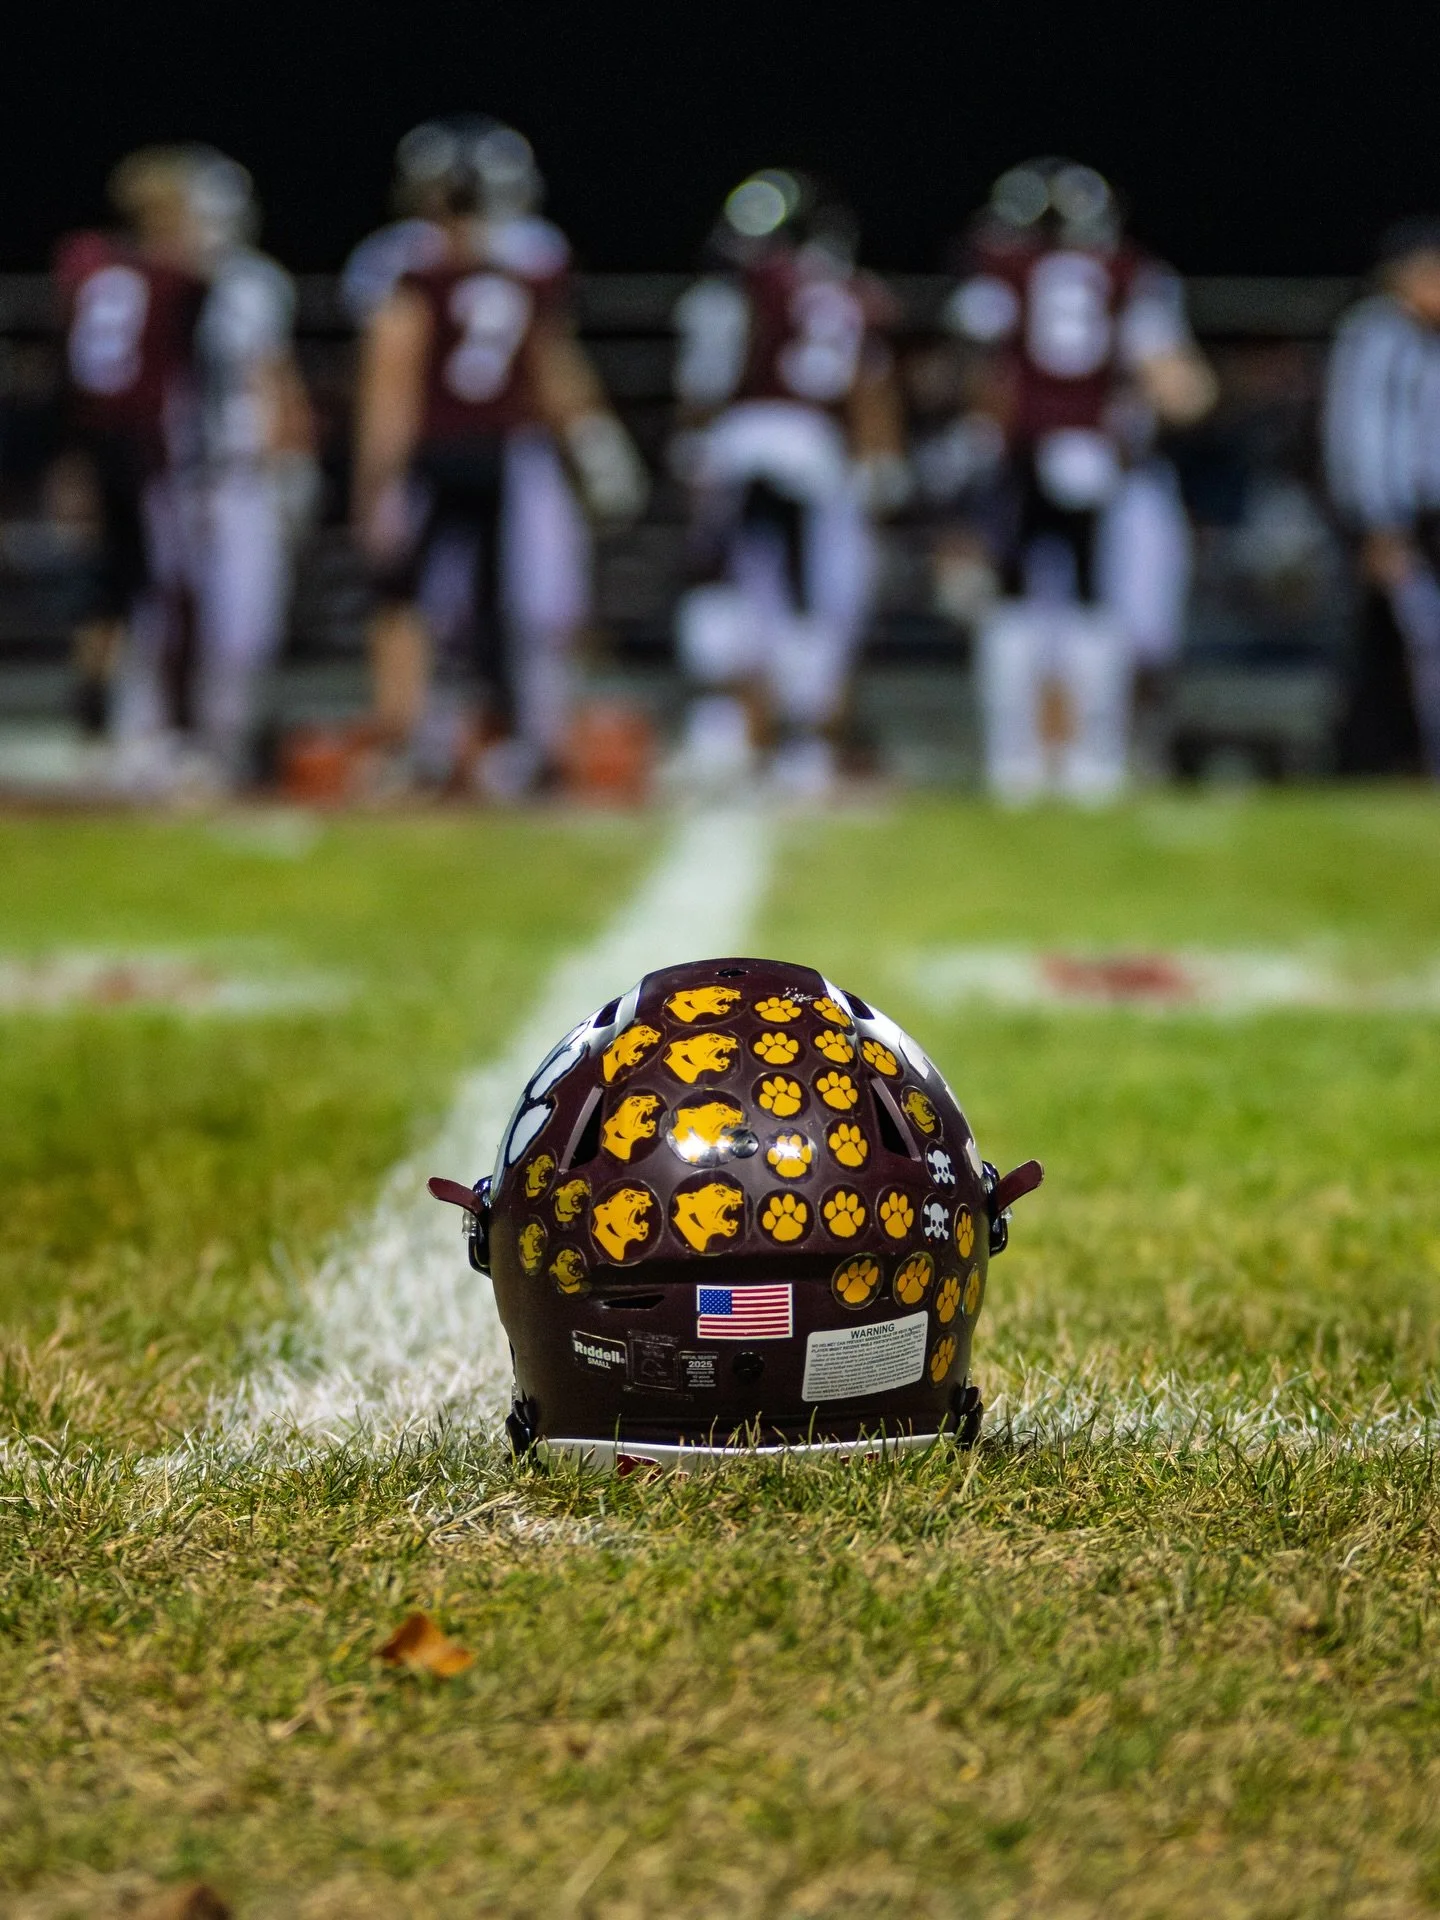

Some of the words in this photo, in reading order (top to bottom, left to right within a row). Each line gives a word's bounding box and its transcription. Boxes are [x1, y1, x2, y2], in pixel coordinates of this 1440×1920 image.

[850, 1323, 895, 1339] WARNING
[574, 1340, 621, 1363] Riddell
[588, 1357, 611, 1370] SMALL
[688, 1360, 713, 1368] 2025
